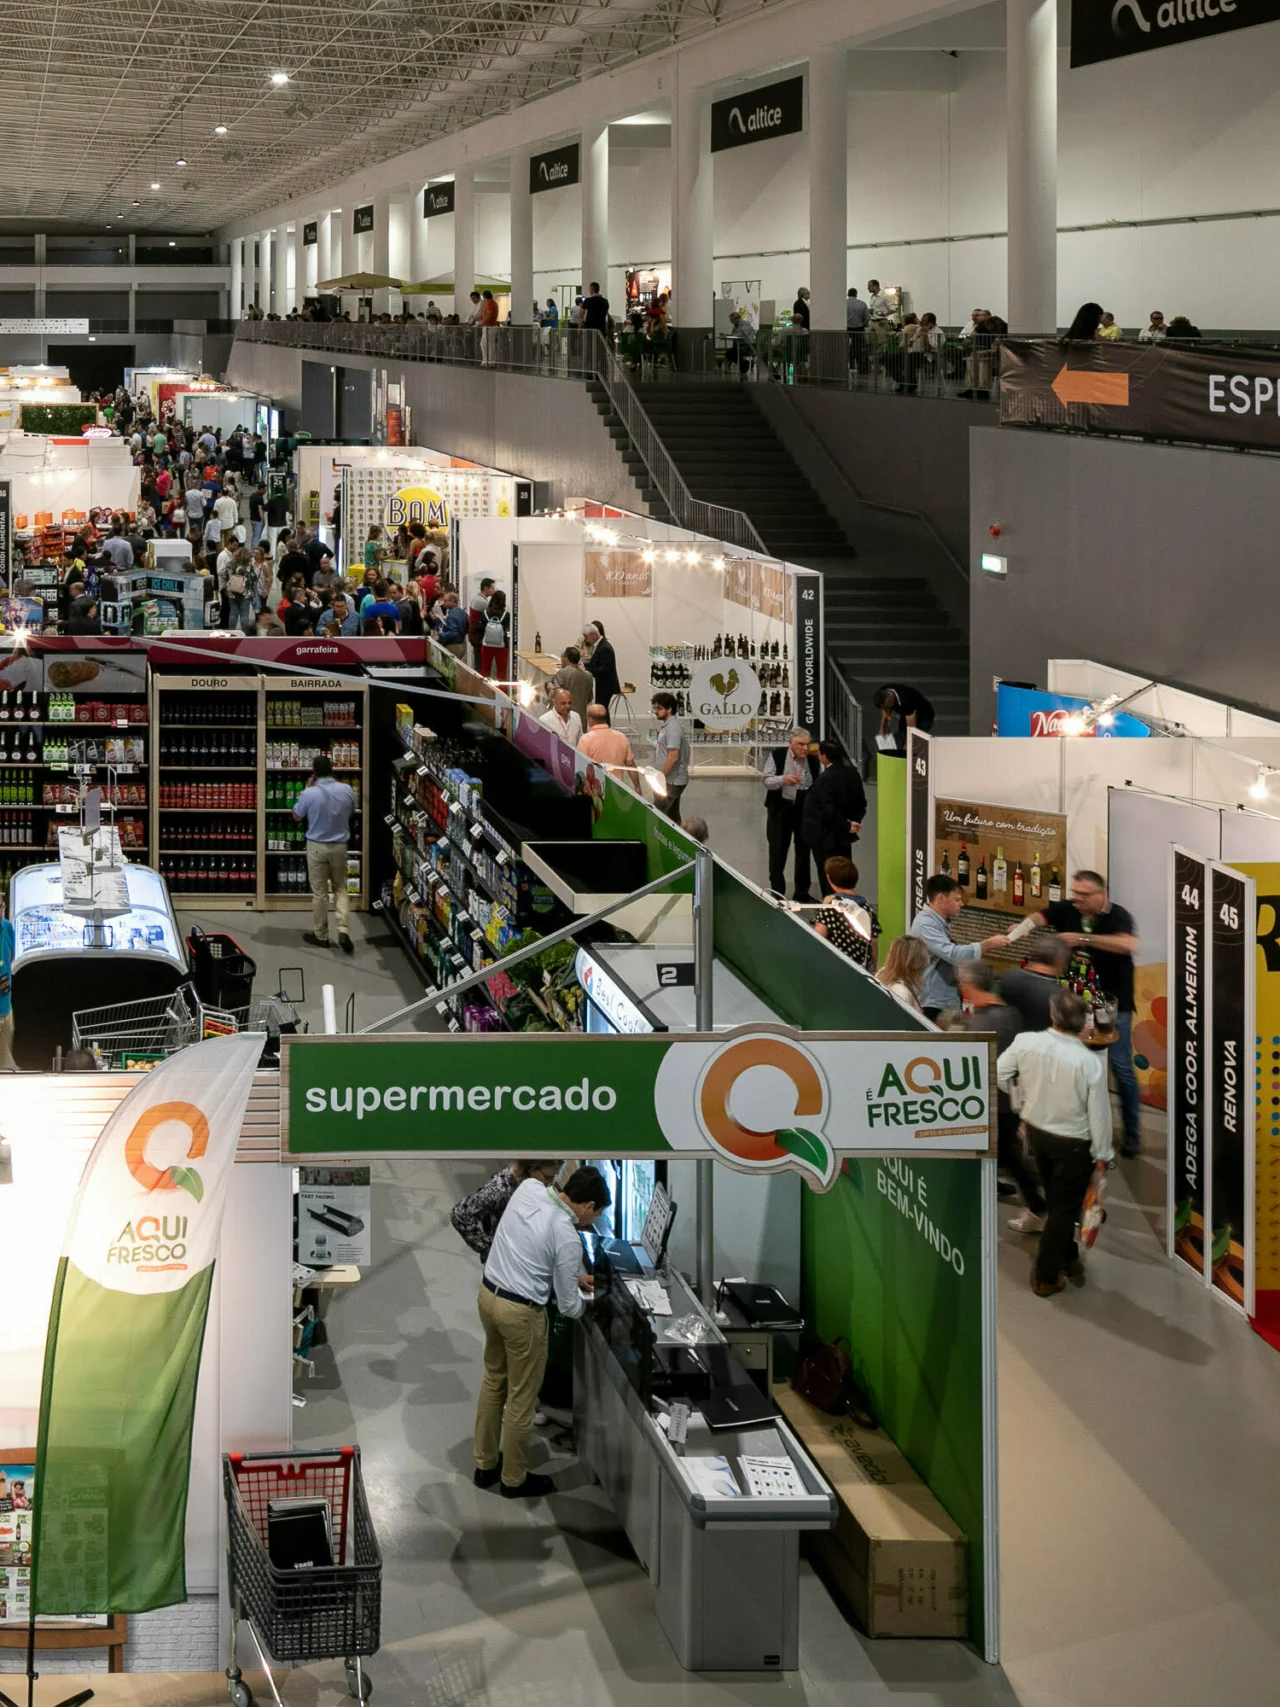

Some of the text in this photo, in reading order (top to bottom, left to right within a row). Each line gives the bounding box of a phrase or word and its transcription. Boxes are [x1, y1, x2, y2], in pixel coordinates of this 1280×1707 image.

[748, 105, 782, 131] altice
[549, 162, 568, 181] altice
[1209, 374, 1280, 417] ESP
[387, 498, 449, 527] BOM
[802, 590, 814, 600] 42
[296, 646, 339, 655] garrafeira
[191, 679, 228, 687] DOURO
[291, 680, 342, 688] BAIRRADA
[805, 618, 814, 724] GALLO WORLDWIDE
[700, 702, 752, 716] GALLO
[915, 758, 926, 776] 43
[944, 810, 962, 823] Um
[963, 813, 993, 827] futuro
[996, 820, 1015, 830] com
[1017, 820, 1057, 837] tradição
[1182, 884, 1199, 910] 44
[1220, 904, 1238, 930] 45
[661, 967, 677, 984] 2
[1185, 926, 1197, 1190] ADEGA COOP. ALMEIRIM
[877, 1056, 982, 1098] AQUI
[1224, 1040, 1237, 1133] RENOVA
[305, 1077, 617, 1120] supermercado
[866, 1088, 985, 1128] É FRESCO
[918, 1176, 928, 1208] É
[117, 1216, 188, 1243] AQUI
[877, 1168, 964, 1276] BEM-VINDO
[107, 1243, 186, 1263] FRESCO
